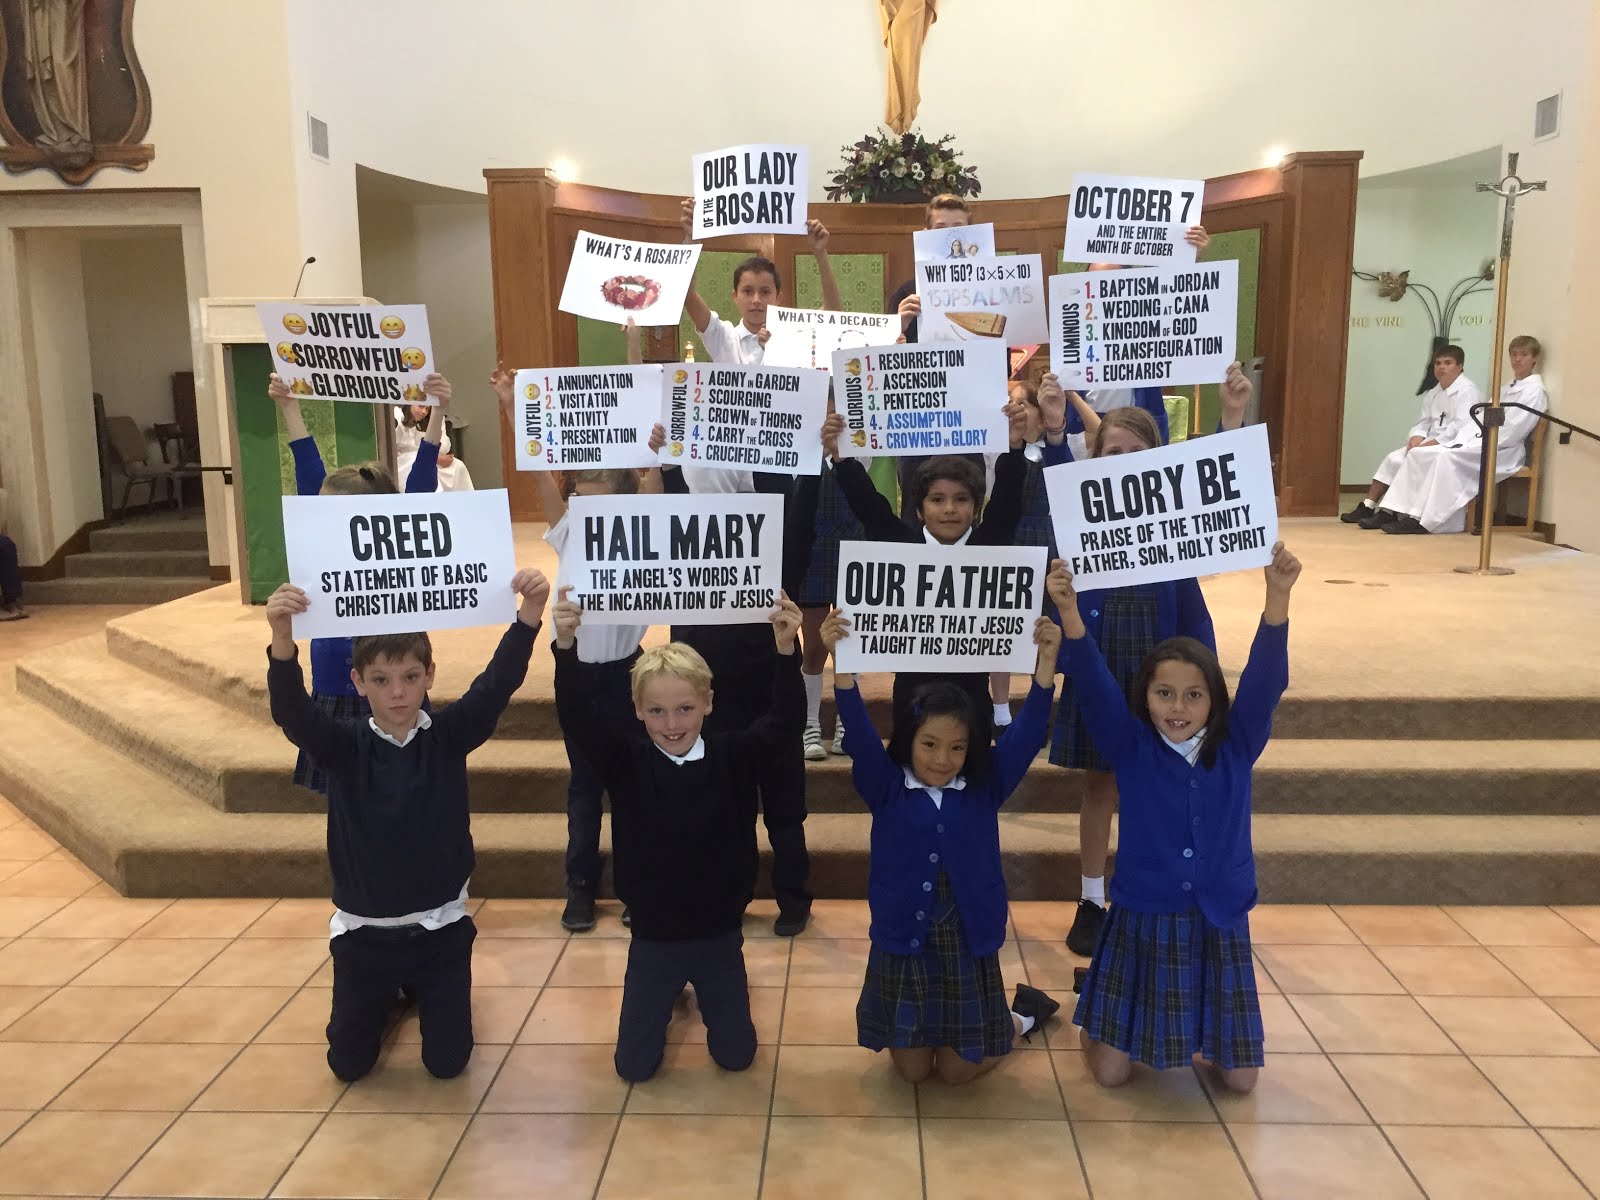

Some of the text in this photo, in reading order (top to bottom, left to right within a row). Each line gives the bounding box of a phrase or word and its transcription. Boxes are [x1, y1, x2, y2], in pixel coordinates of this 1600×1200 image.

[704, 152, 797, 191] OUR LADY
[704, 198, 713, 227] OF THE
[716, 191, 795, 226] ROSARY
[1074, 186, 1194, 223] OCTOBER 7
[1097, 225, 1168, 240] AND THE ENTIRE
[586, 238, 692, 264] WHAT'S A ROSARY?
[1087, 240, 1173, 256] MONTH OF OCTOBER
[925, 265, 946, 282] WHY
[950, 264, 972, 282] 150?
[1100, 276, 1158, 298] BAPTISM
[1161, 284, 1167, 294] IN
[1170, 271, 1219, 293] JORDAN
[1103, 299, 1160, 319] WEDDING
[1163, 306, 1172, 315] AT
[1175, 294, 1209, 314] CANA
[308, 312, 380, 339] JOYFUL
[778, 311, 888, 327] WHAT'S A DECADE?
[1103, 320, 1160, 340] KINGDOM
[1163, 328, 1170, 337] OF
[1173, 317, 1197, 336] GOD
[1459, 316, 1483, 326] YOU
[1062, 303, 1080, 364] LUMINOUS
[292, 343, 409, 372] SORROWFUL
[879, 350, 964, 370] RESURRECTION
[1104, 336, 1222, 361] TRANSFIGURATION
[558, 373, 633, 391] ANNUNCIATION
[709, 370, 747, 387] AGONY
[748, 380, 753, 388] IN
[756, 373, 800, 392] GARDEN
[883, 371, 946, 390] ASCENSION
[1103, 361, 1172, 382] EUCHARIST
[311, 373, 401, 400] GLORIOUS
[560, 392, 617, 409] VISITATION
[709, 389, 771, 408] SCOURGING
[846, 377, 864, 429] GLORIOUS
[884, 391, 947, 410] PENTECOST
[526, 401, 541, 439] JOYFUL
[560, 411, 609, 427] NATIVITY
[671, 385, 687, 441] SORROWFUL
[708, 407, 749, 426] CROWN
[751, 418, 757, 426] OF
[760, 411, 802, 429] THORNS
[887, 411, 961, 430] ASSUMPTION
[562, 428, 636, 445] PRESENTATION
[708, 425, 745, 444] CARRY
[747, 437, 756, 445] THE
[759, 430, 793, 448] CROSS
[887, 431, 942, 449] CROWNED
[944, 439, 950, 447] IN
[952, 429, 987, 447] GLORY
[561, 447, 601, 463] FINDING
[706, 444, 760, 464] CRUCIFIED
[762, 457, 773, 465] AND
[775, 450, 798, 467] DIED
[1081, 453, 1240, 523] GLORY BE
[350, 513, 452, 561] CREED
[585, 514, 765, 561] HAIL MARY
[1080, 504, 1251, 552] PRAISE OF THE TRINITY
[1072, 526, 1266, 574] FATHER, SON, HOLY SPIRIT
[322, 563, 487, 593] STATEMENT OF BASIC
[590, 566, 761, 589] THE ANGEL'S WORDS AT
[845, 562, 1034, 609] OUR FATHER
[336, 588, 478, 617] CHRISTIAN BELIEFS
[578, 589, 774, 611] THE INCARNATION OF JESUS
[853, 613, 1023, 634] THE PRAYER THAT JESUS
[861, 635, 1012, 656] TAUGHT HIS DISCIPLES
